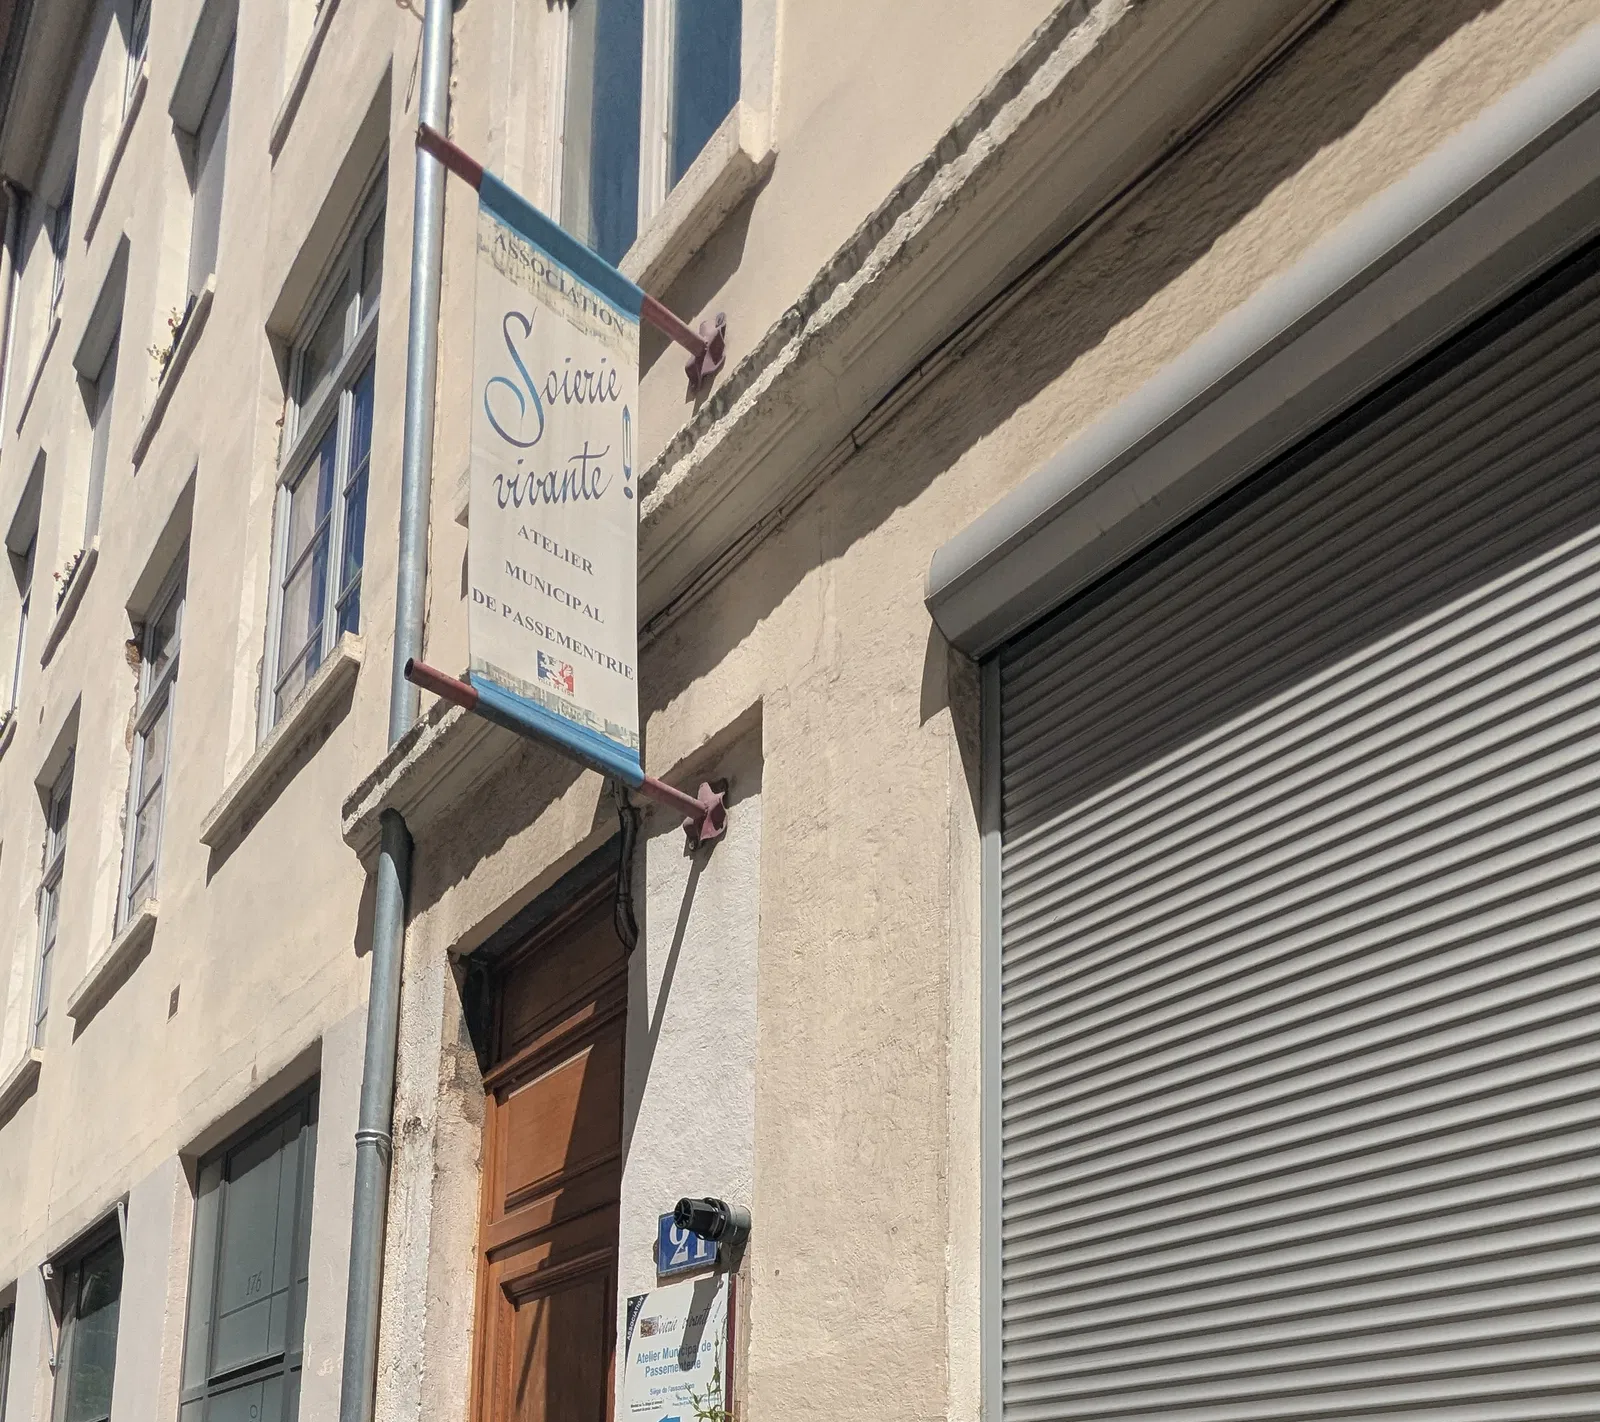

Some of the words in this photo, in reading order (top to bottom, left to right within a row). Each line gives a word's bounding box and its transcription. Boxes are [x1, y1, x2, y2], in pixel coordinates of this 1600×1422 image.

[494, 233, 625, 337] ASSOCIATION
[484, 306, 622, 448] Soierie
[492, 441, 613, 509] vivante
[517, 524, 594, 575] ATELIER
[505, 560, 605, 624] MUNICIPAL
[472, 587, 497, 613] DE
[501, 603, 634, 681] PASSEMENTRIE
[669, 1222, 708, 1265] 21
[246, 1271, 262, 1296] 176
[627, 1296, 644, 1341] ASSOCIATION
[636, 1351, 661, 1364] Atelier
[662, 1342, 699, 1360] Municipal
[701, 1340, 712, 1352] de
[645, 1358, 701, 1377] Passementerie
